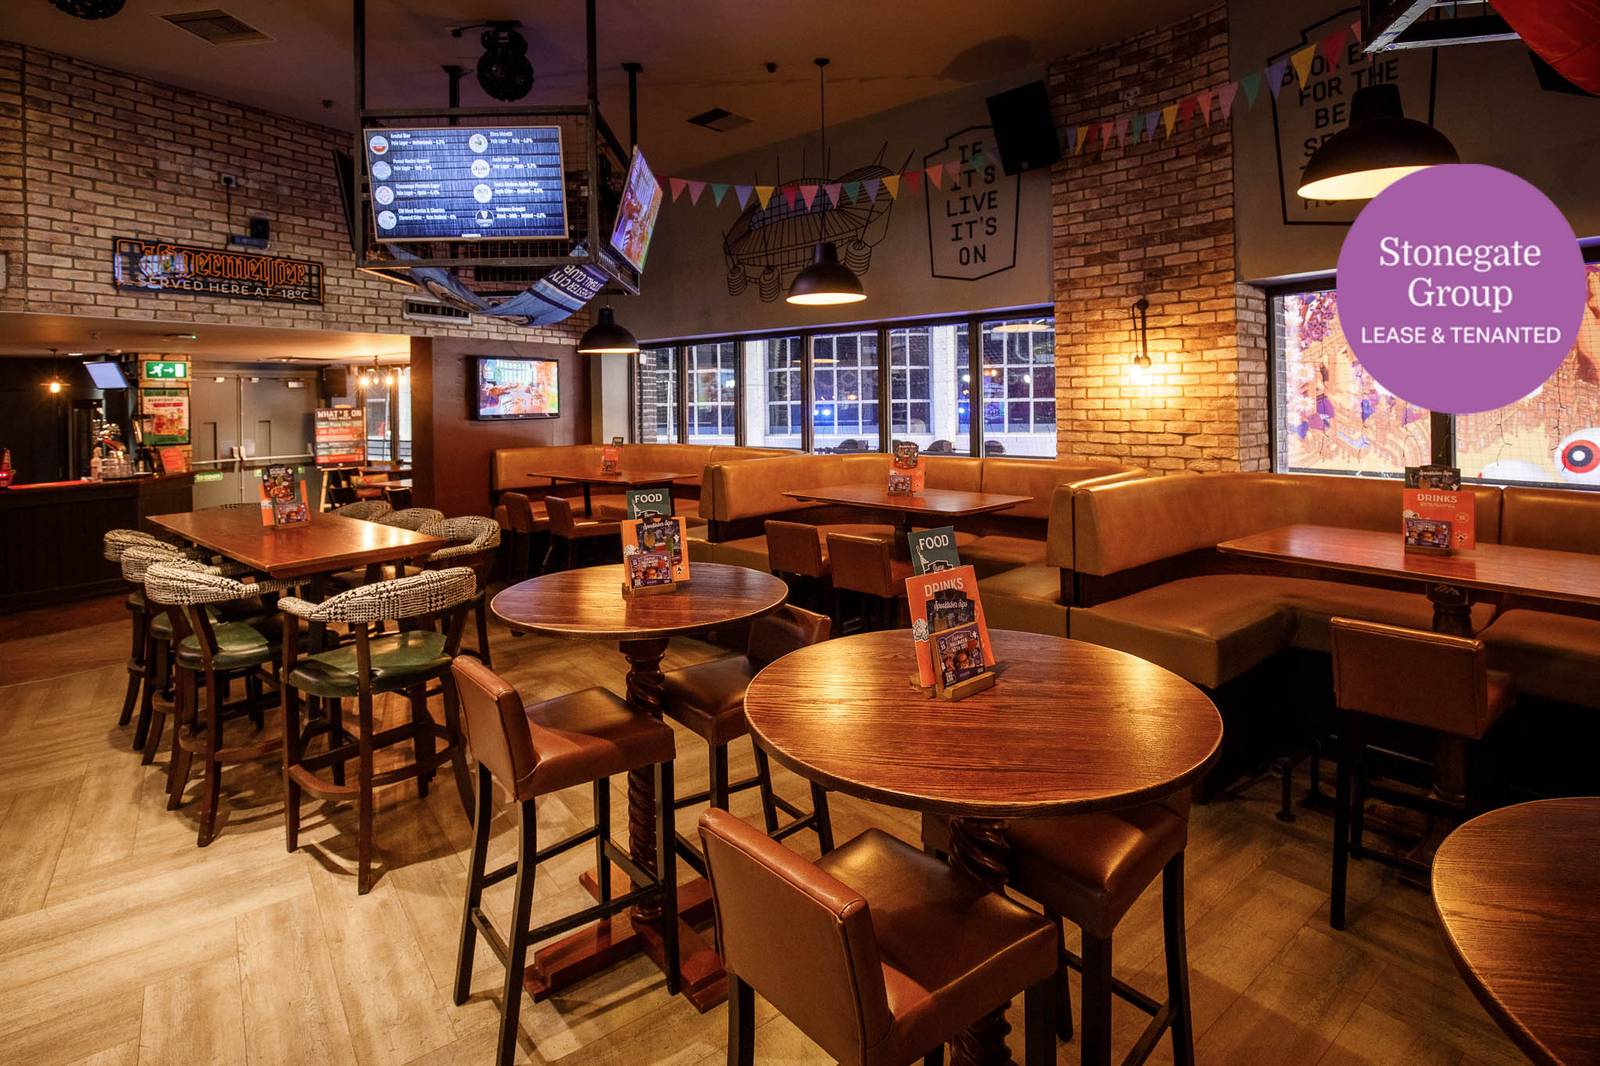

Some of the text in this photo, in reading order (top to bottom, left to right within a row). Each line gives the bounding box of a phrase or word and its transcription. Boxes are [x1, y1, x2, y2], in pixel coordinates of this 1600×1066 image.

[1298, 58, 1398, 106] FOR THE
[958, 141, 983, 165] IF
[946, 190, 998, 218] LIVE
[951, 216, 997, 242] IT'S
[959, 244, 987, 266] ON
[563, 264, 587, 283] CLUB
[209, 282, 249, 295] HERE
[254, 287, 273, 297] AT
[634, 493, 663, 503] FOOD
[1417, 493, 1458, 503] DRINKS
[918, 534, 949, 551] FOOD
[924, 577, 965, 598] DRINKS
